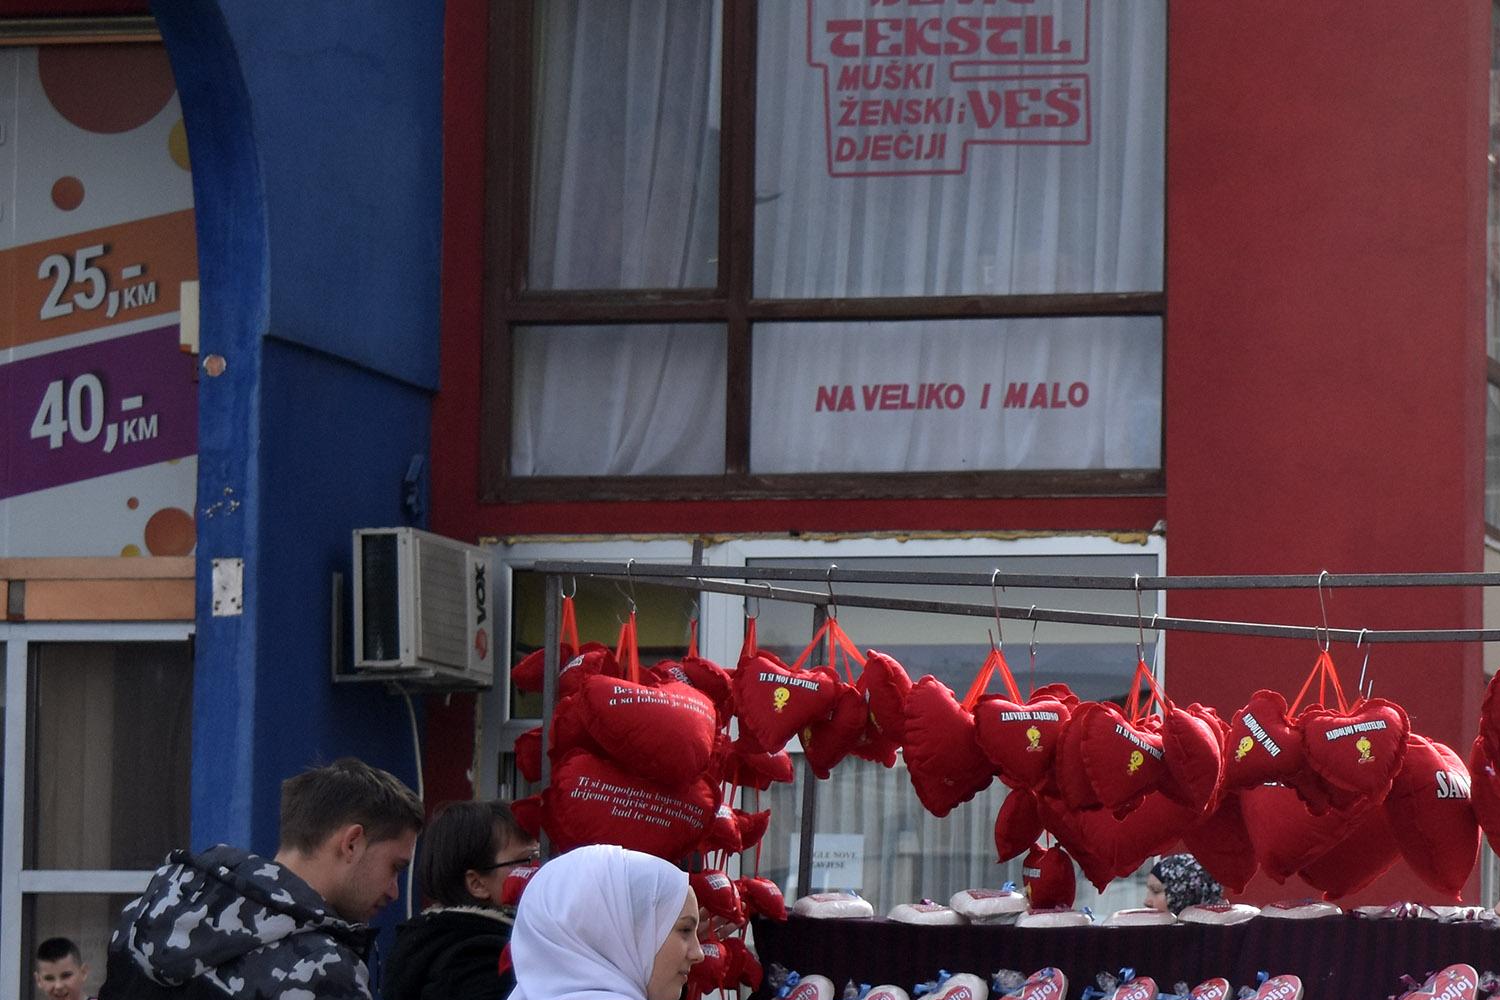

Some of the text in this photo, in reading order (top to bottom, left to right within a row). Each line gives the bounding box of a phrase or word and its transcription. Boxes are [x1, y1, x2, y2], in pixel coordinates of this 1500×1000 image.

[826, 15, 1073, 58] TEKSTIL
[836, 59, 935, 92] MUŠKI
[837, 81, 1082, 129] ŽENSKI i VEŠ
[834, 129, 948, 163] DJEČIJI
[815, 381, 1090, 412] NA VELIKO I MALO
[473, 561, 488, 626] VOX
[760, 672, 767, 682] TI
[767, 673, 775, 682] SI
[775, 674, 788, 685] MOJ
